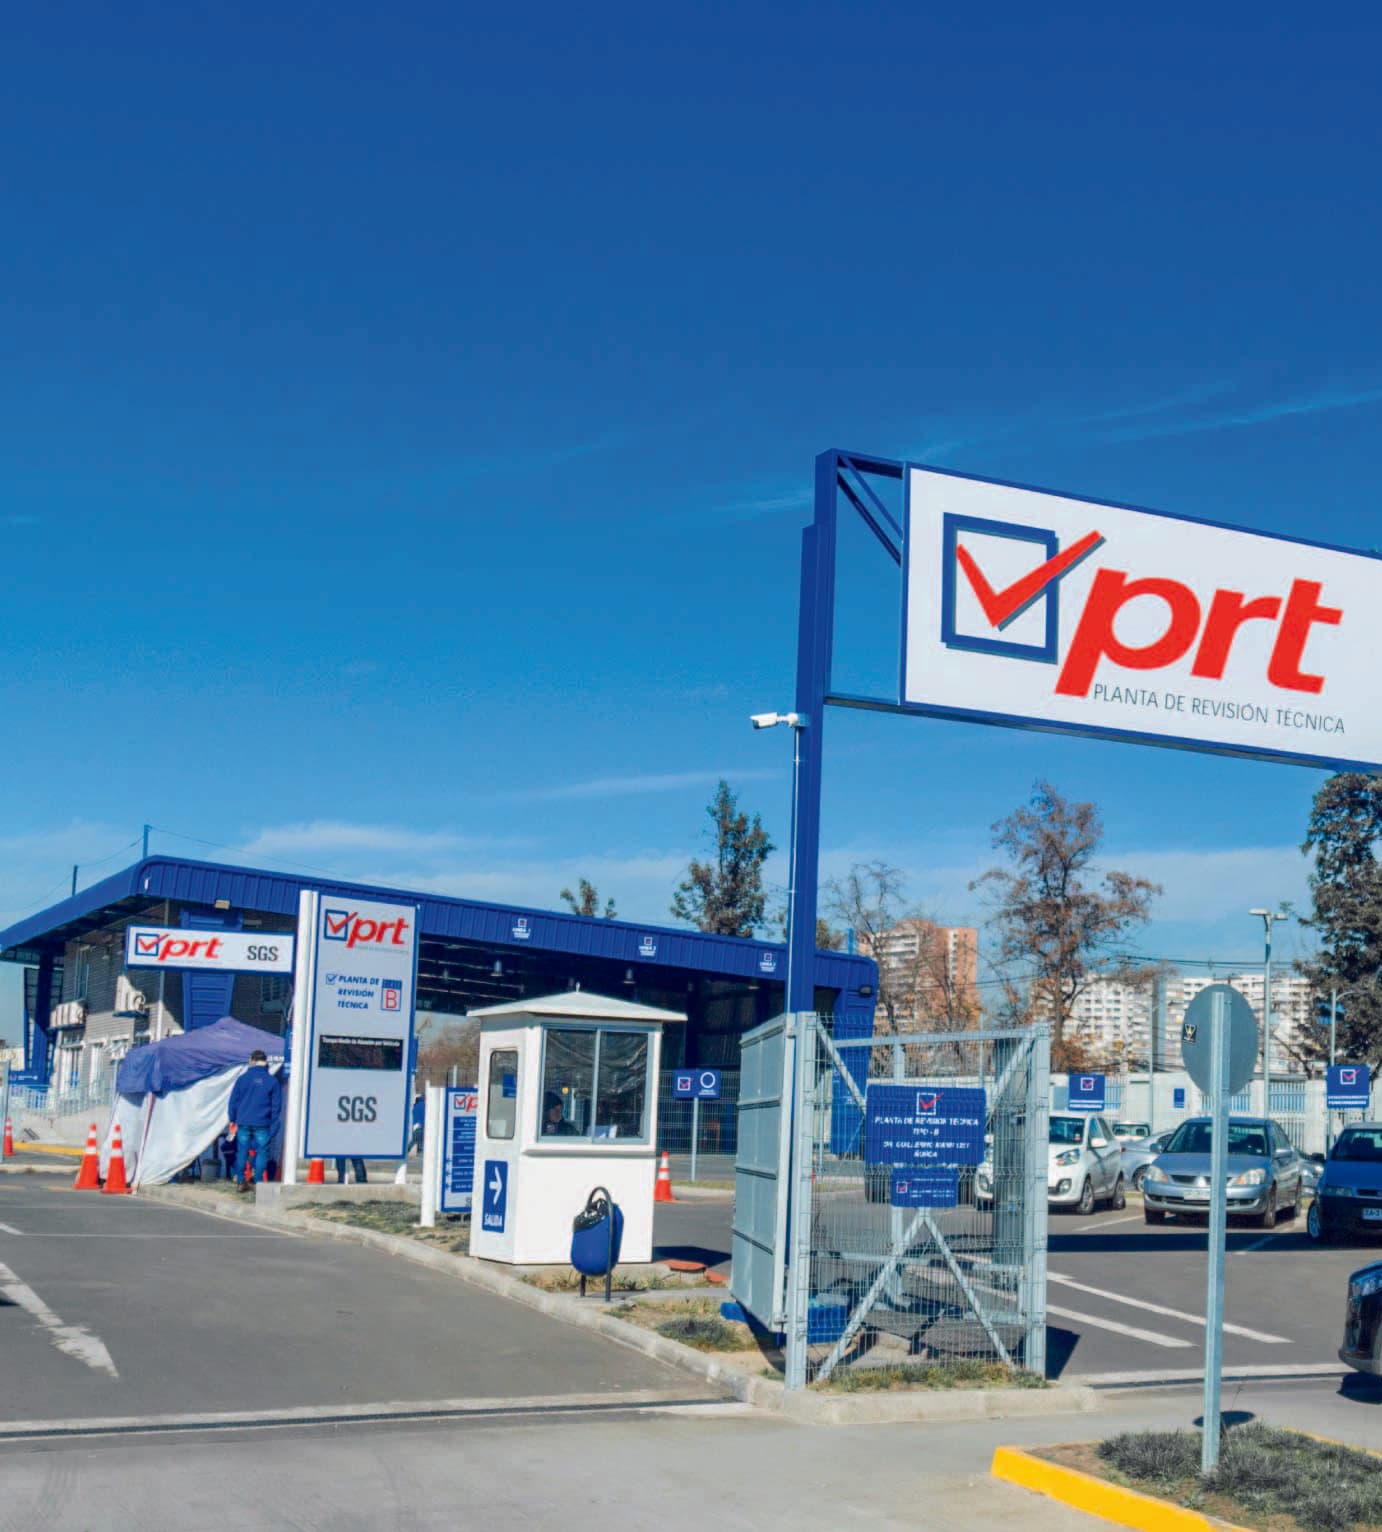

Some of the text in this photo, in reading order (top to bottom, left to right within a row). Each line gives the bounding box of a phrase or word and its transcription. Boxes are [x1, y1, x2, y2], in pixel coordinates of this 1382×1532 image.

[1055, 567, 1343, 698] prt
[1093, 683, 1346, 734] PLANTA DE REVISIÓN TÉCNICA
[345, 917, 409, 949] prt
[158, 937, 278, 961] prt SGS
[338, 975, 368, 985] PLANTA
[369, 977, 380, 985] DE
[385, 989, 397, 1009] B
[337, 1095, 377, 1122] SGS
